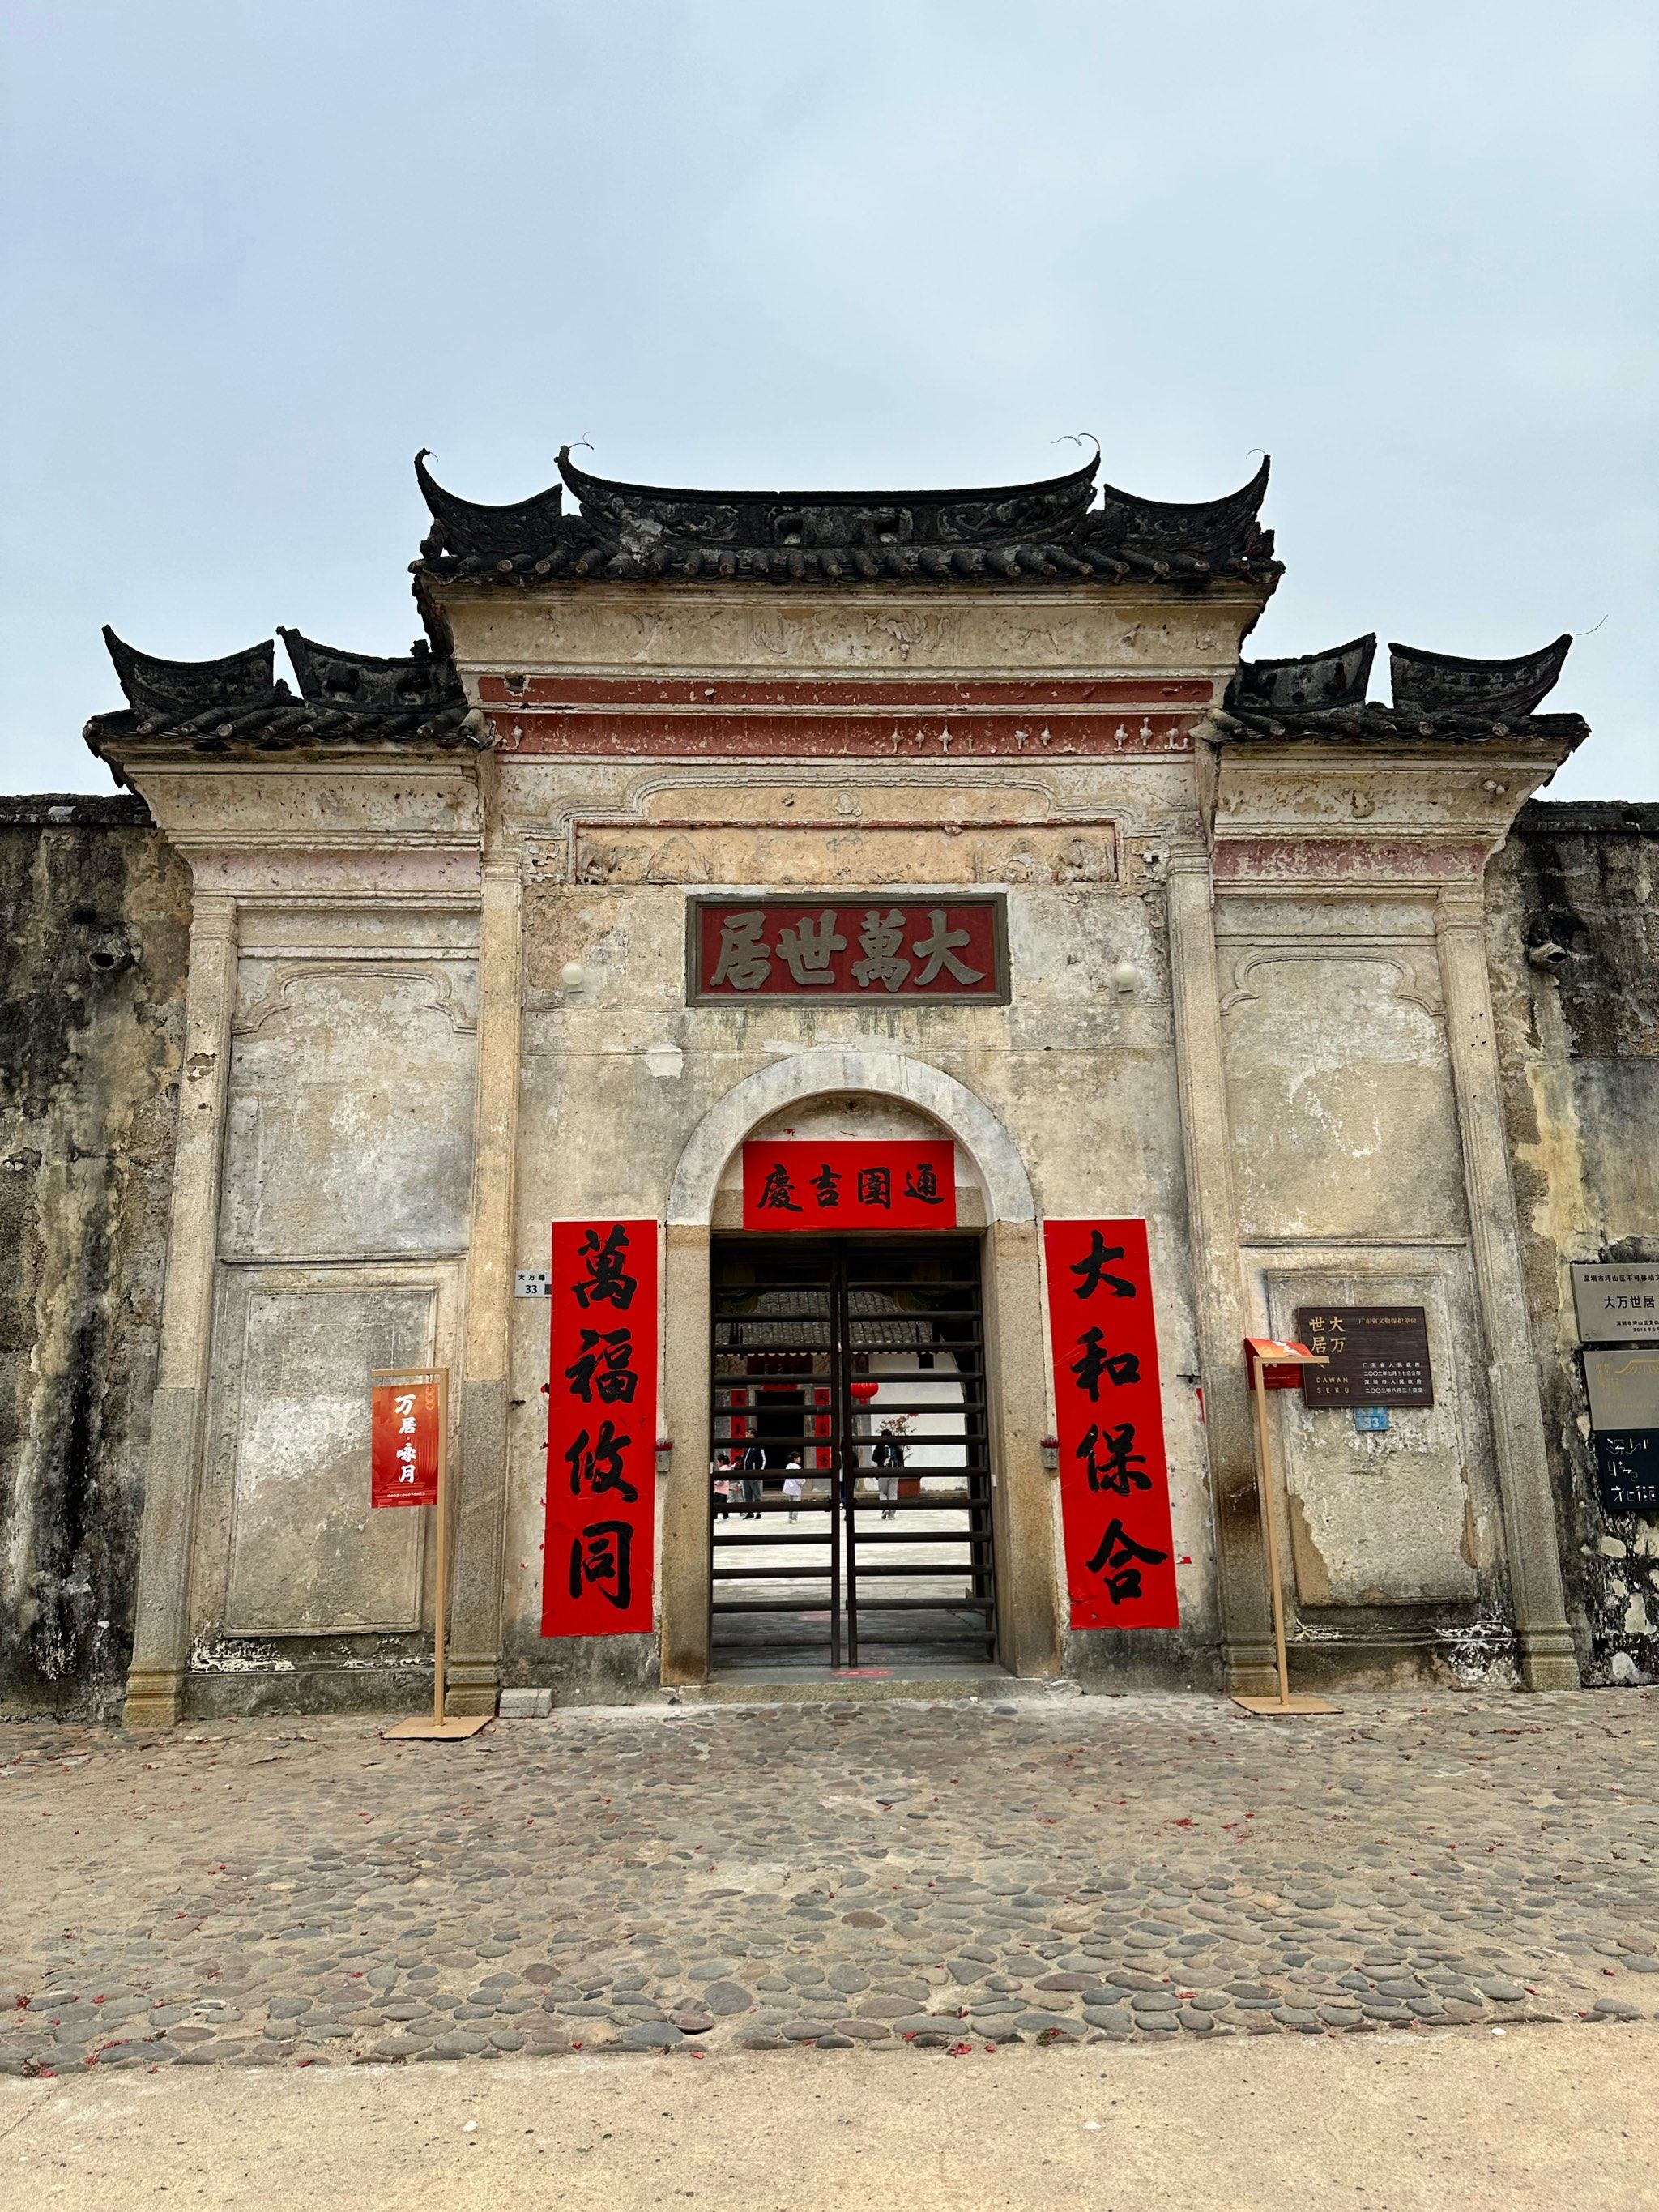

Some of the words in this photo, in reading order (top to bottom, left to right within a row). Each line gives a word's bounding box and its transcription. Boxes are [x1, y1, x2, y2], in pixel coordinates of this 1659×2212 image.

[710, 908, 987, 993] 大萬世居
[525, 1284, 537, 1294] 33
[1604, 1295, 1655, 1309] 大万世居
[564, 1224, 638, 1611] 萬福攸同
[1069, 1229, 1168, 1606] 大和保合
